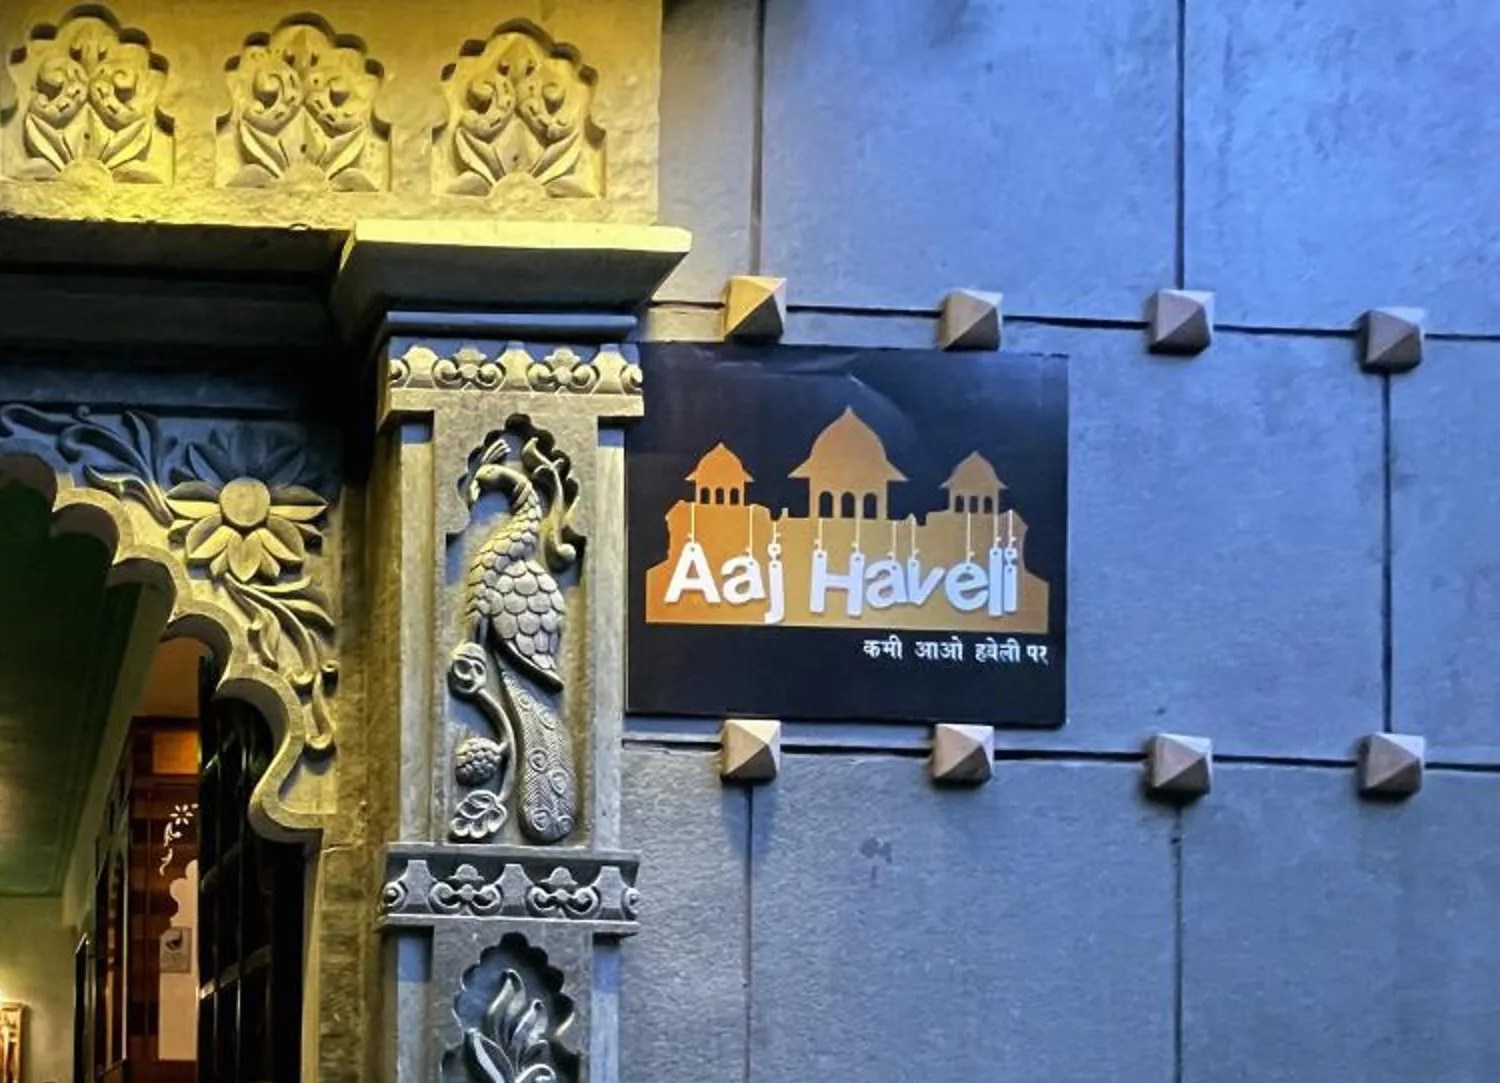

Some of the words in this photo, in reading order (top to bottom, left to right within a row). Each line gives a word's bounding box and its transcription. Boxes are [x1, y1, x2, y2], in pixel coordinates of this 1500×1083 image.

[664, 542, 785, 624] Aaj
[809, 546, 1018, 617] Haveli
[1026, 644, 1049, 666] पर
